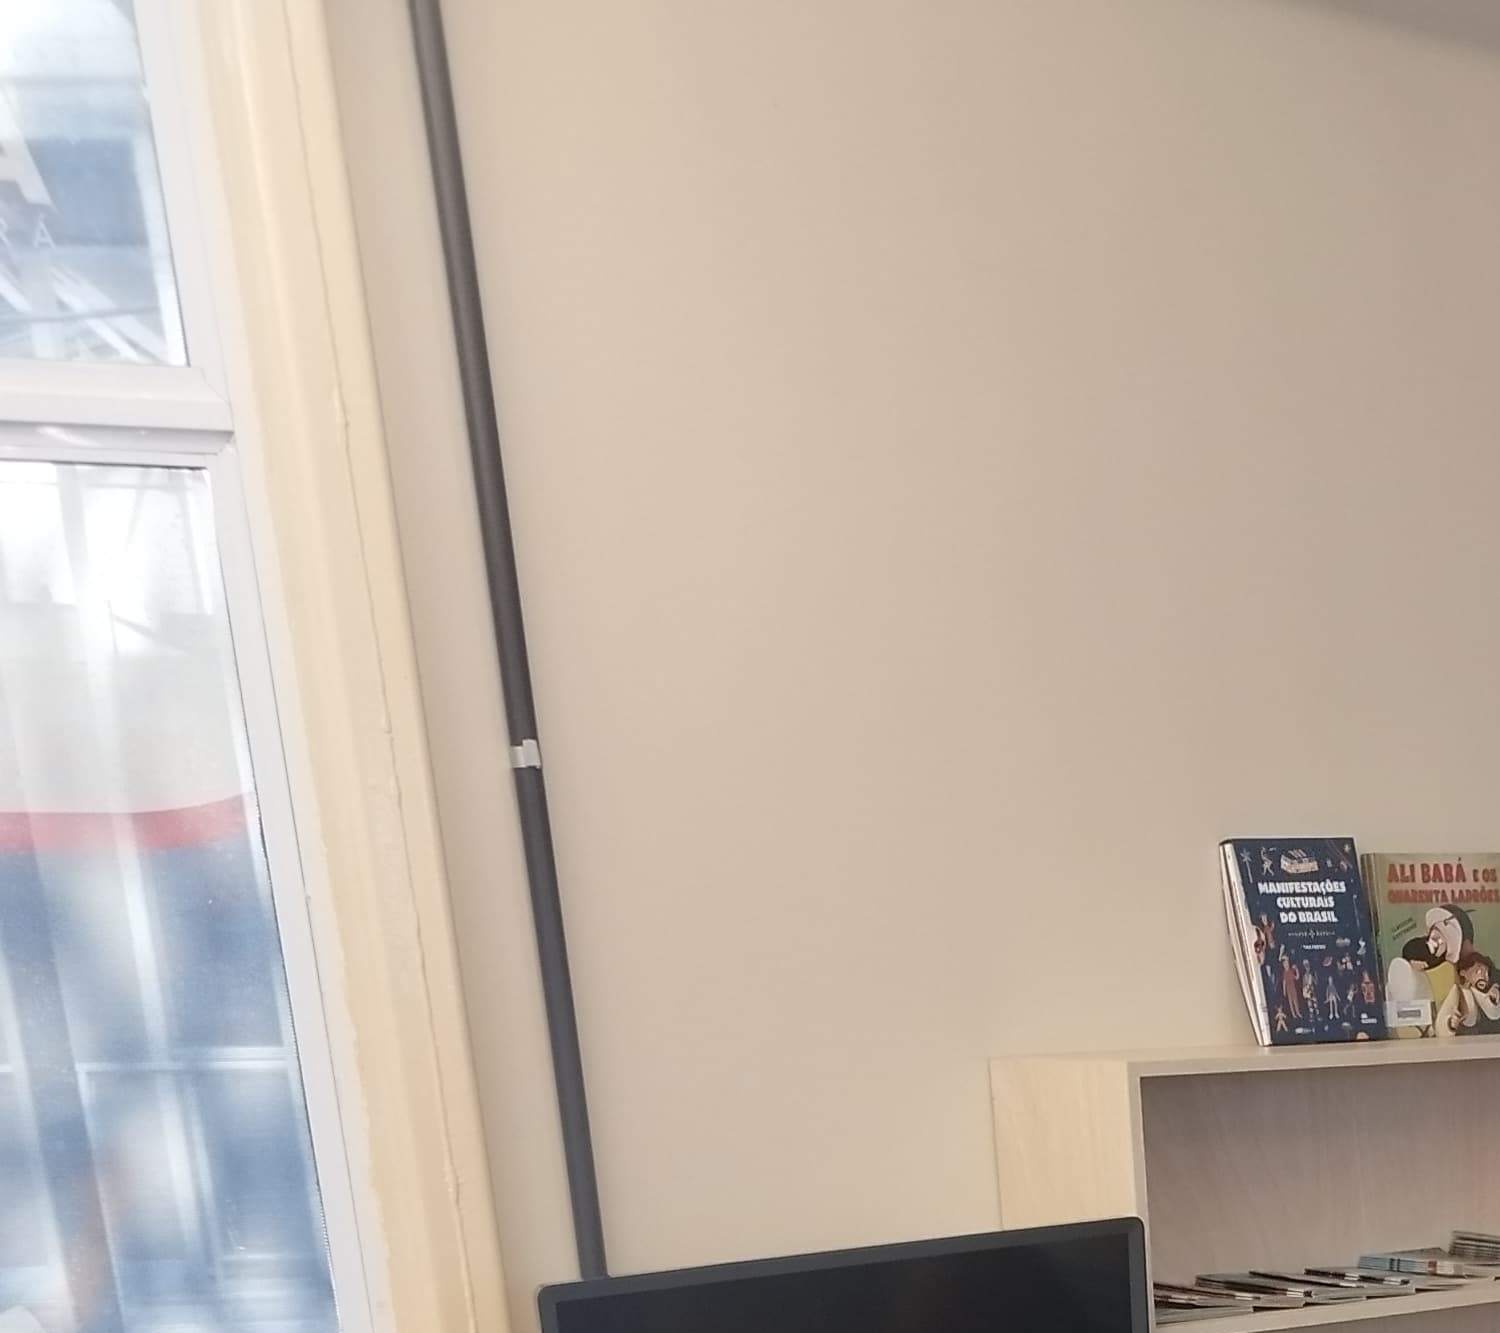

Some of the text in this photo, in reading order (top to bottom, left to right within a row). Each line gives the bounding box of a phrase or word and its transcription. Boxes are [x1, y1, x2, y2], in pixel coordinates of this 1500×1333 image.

[1388, 863, 1416, 883] ALI
[1421, 857, 1466, 883] BABÁ
[1257, 879, 1346, 895] MANIFESTAÇÕES
[1276, 895, 1335, 909] CULTURAIS
[1280, 911, 1339, 923] DO BRASIL
